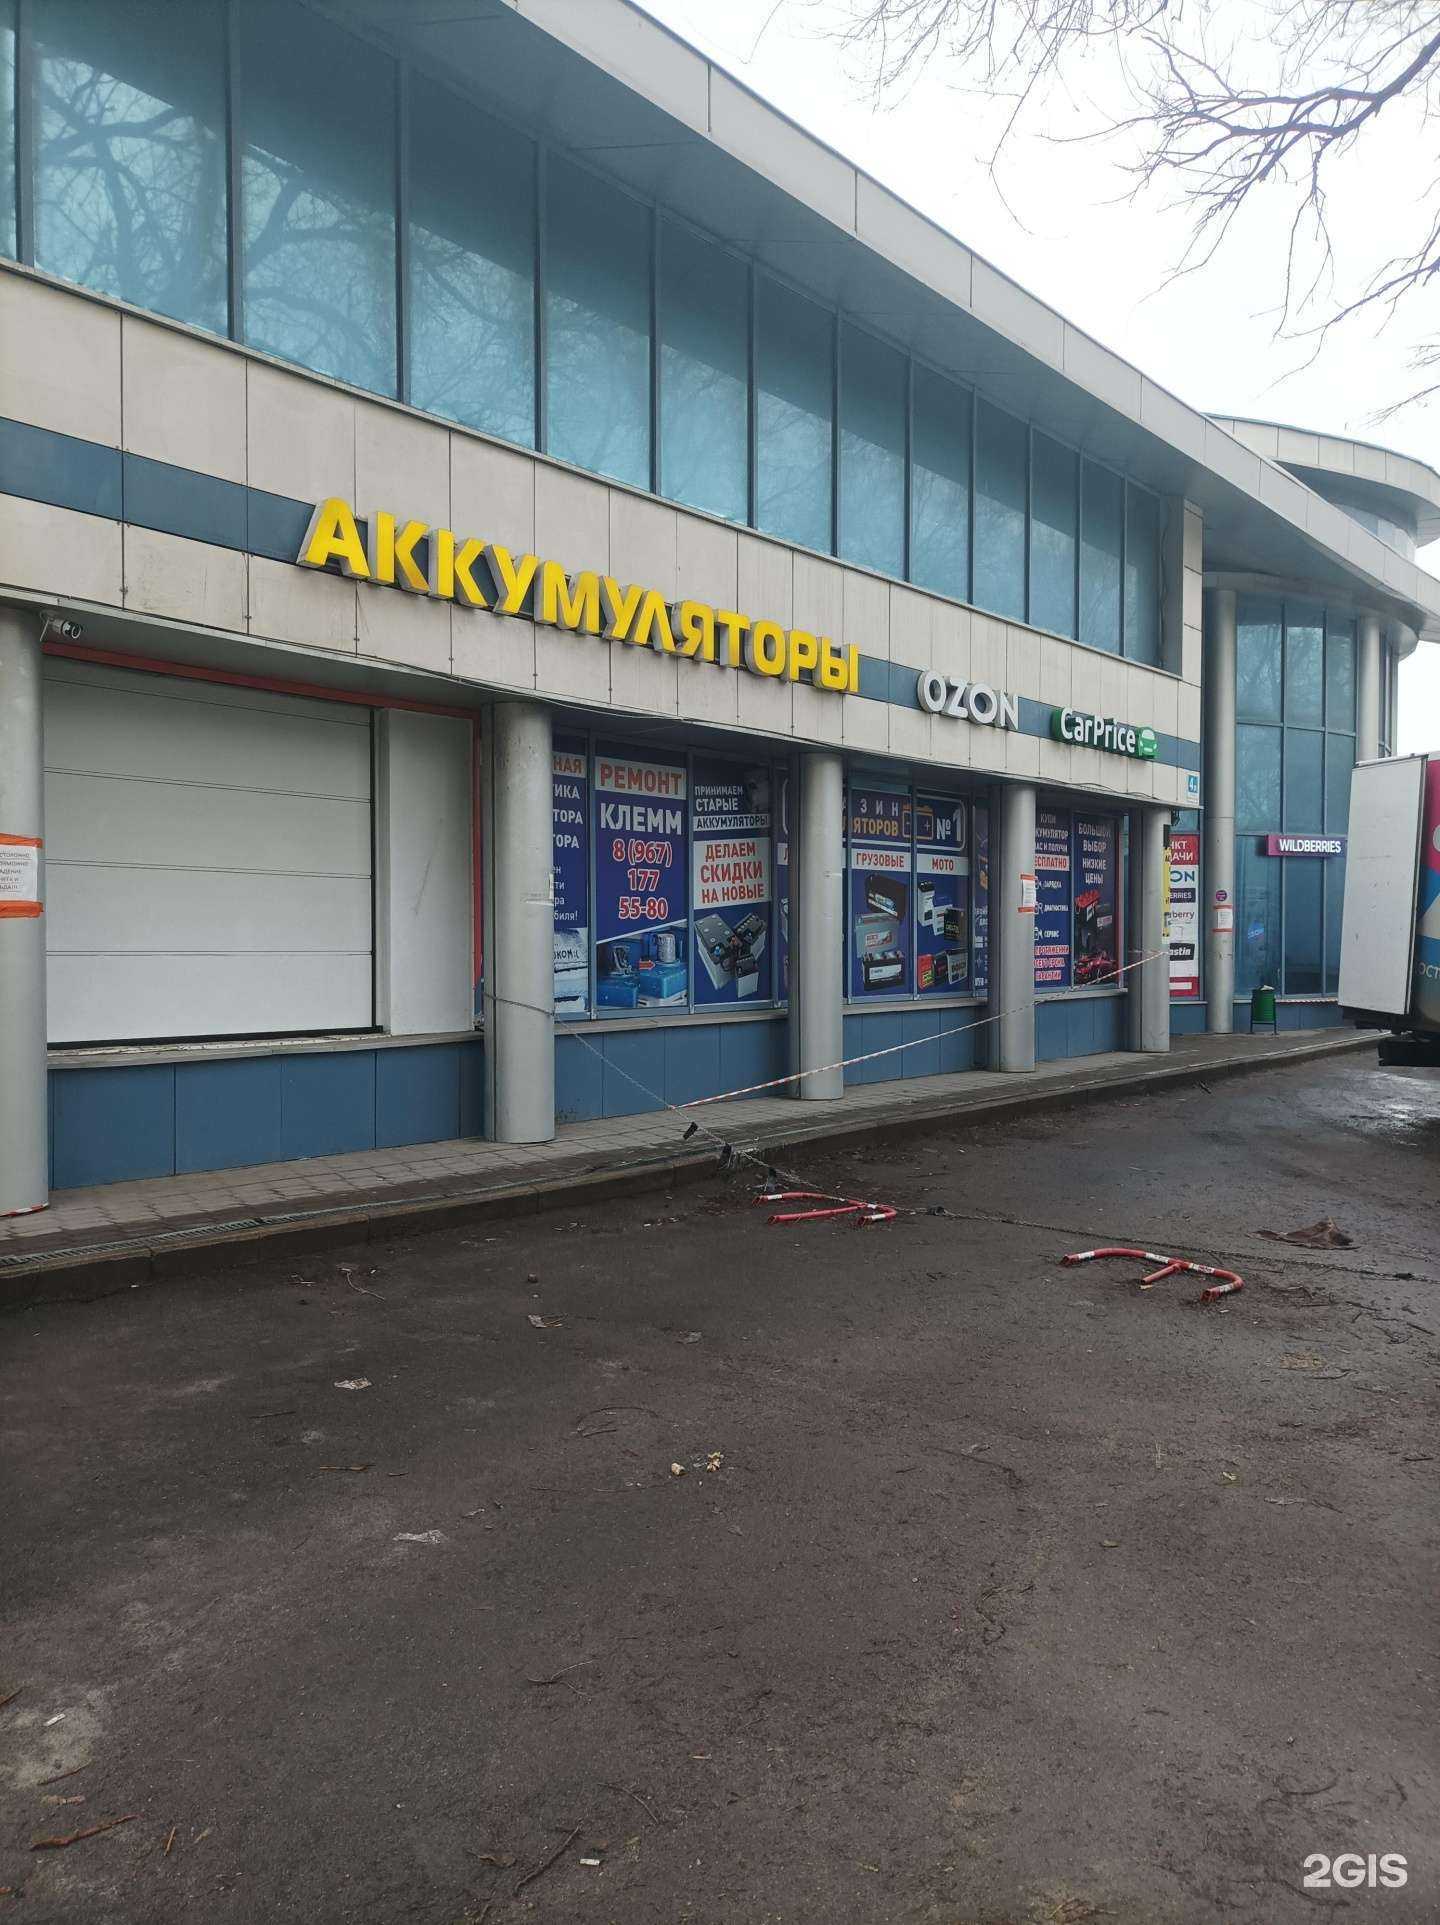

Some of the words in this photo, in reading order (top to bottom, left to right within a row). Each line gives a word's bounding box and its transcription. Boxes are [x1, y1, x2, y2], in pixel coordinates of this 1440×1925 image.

[297, 497, 859, 693] АККУМУЛЯТОРЫ
[917, 669, 1019, 730] OZON
[1060, 707, 1136, 753] CarPrice
[600, 763, 682, 795] РЕМОНТ
[552, 783, 580, 799] ИКА
[695, 786, 743, 796] ПРИНИМАЕМ
[695, 798, 738, 812] СТАРЫЕ
[600, 803, 682, 835] КЛЕММ
[697, 816, 768, 829] АККУМУЛЯТОРЫ
[853, 816, 899, 836] ЯТОРОВ
[552, 833, 580, 848] ОРА
[1083, 840, 1107, 852] ВЫБОР
[1279, 839, 1342, 853] WILDBERRIES
[612, 839, 625, 862] 8
[627, 838, 673, 868] (967)
[705, 842, 756, 862] ДЕЛАЕМ
[856, 852, 904, 868] ГРУЗОВЫЕ
[700, 861, 763, 884] СКИДКИ
[932, 858, 954, 871] МОТО
[1082, 858, 1107, 870] НИЗКИЕ
[627, 868, 660, 892] 177
[1085, 873, 1104, 884] ЦЕНЫ
[701, 887, 719, 904] НА
[722, 883, 764, 902] НОВЫЕ
[618, 896, 669, 920] 55-80
